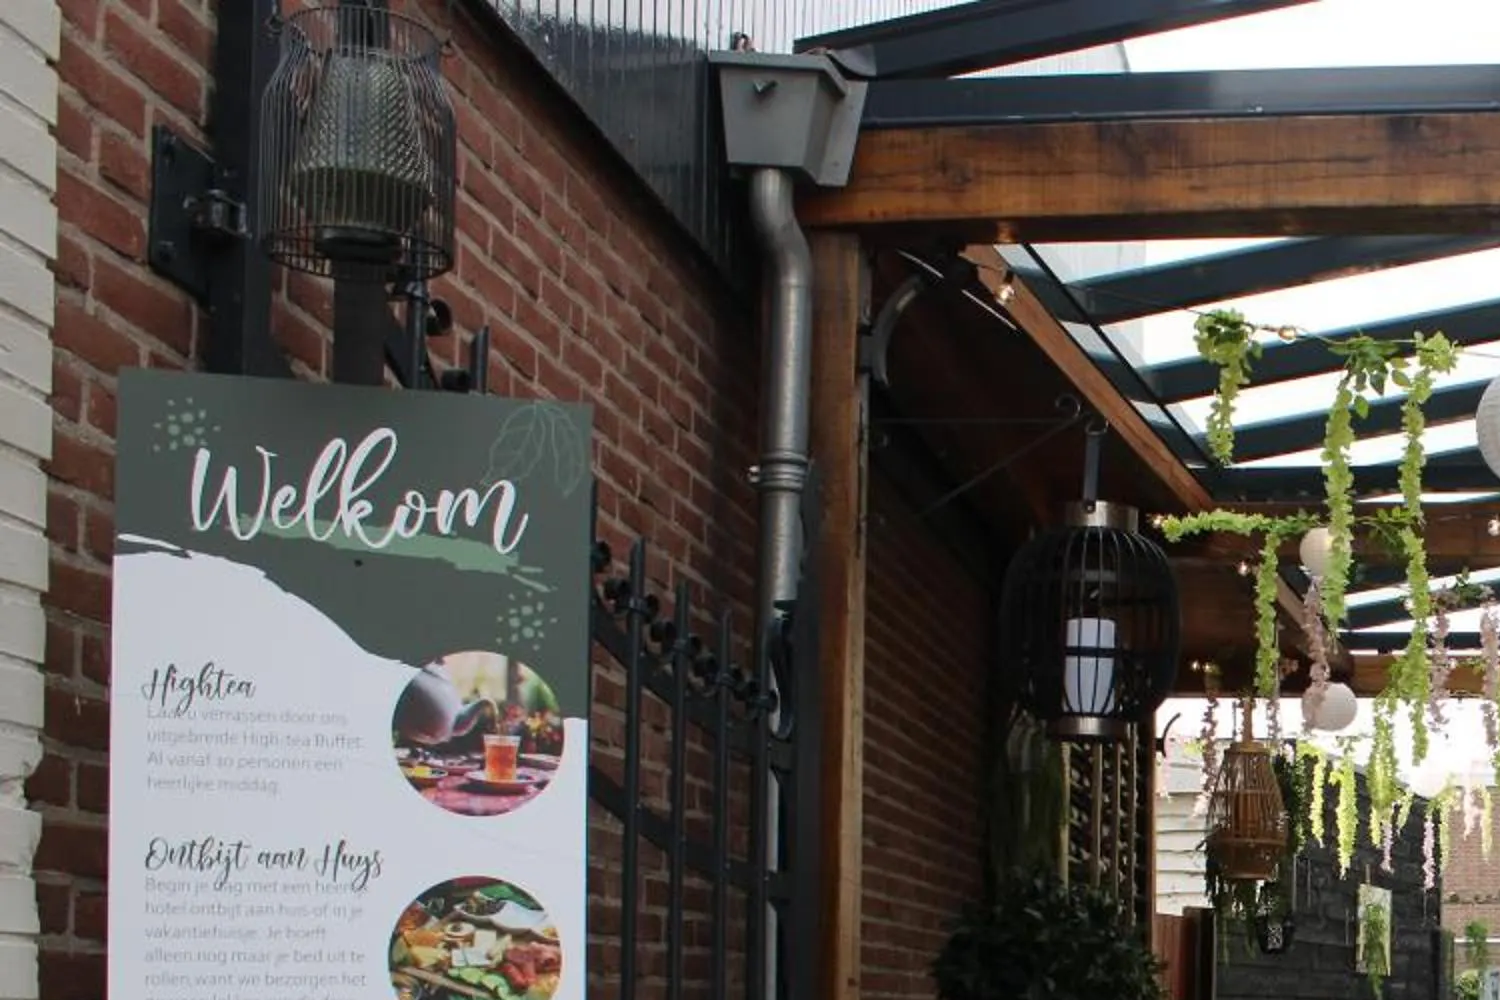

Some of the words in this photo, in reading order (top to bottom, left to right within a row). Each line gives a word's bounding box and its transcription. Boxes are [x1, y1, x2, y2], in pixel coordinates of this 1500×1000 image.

[189, 427, 530, 555] Welkom
[141, 662, 257, 713] Hightea
[144, 836, 252, 891] Ontbijt
[257, 847, 309, 870] aan
[314, 839, 385, 893] Huys
